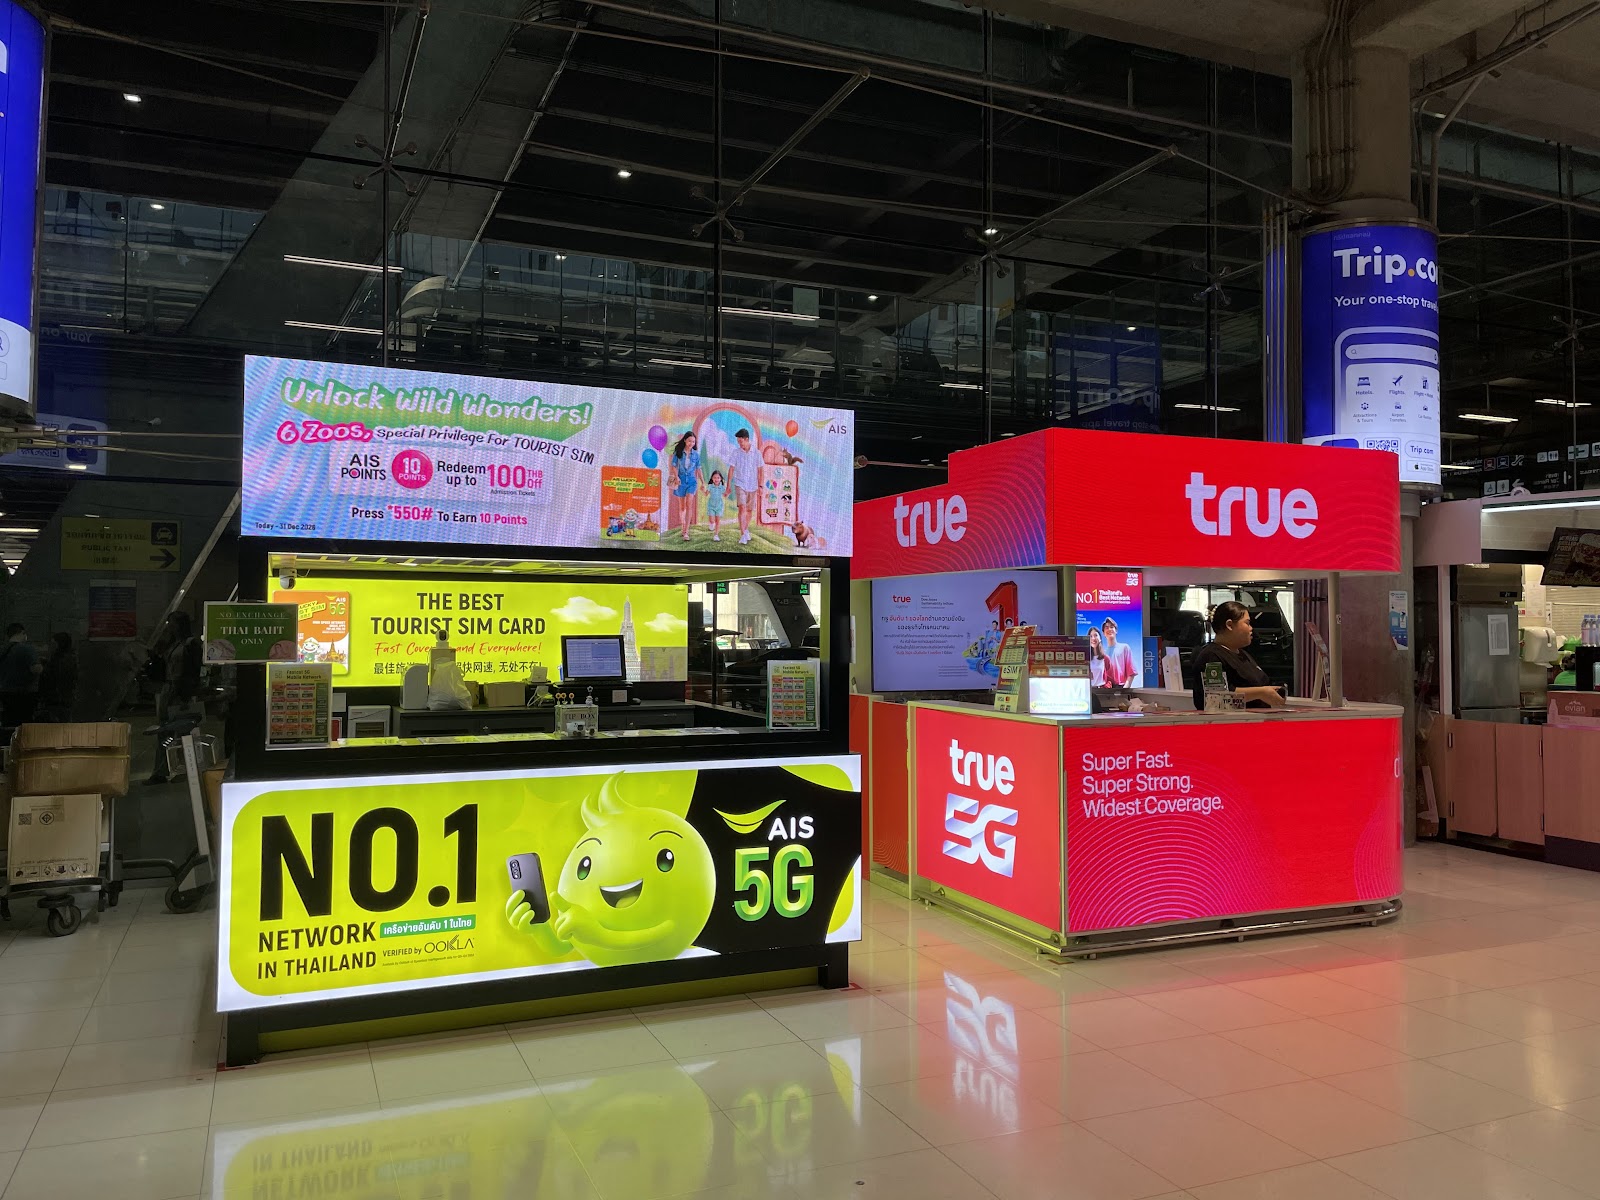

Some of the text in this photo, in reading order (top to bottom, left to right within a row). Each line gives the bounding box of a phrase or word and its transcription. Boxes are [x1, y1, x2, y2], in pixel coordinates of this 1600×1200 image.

[1334, 246, 1438, 284] Trip.co
[1334, 295, 1365, 308] Your
[1369, 294, 1419, 309] one-stop
[284, 378, 590, 425] Unlock Wild Wonders!
[828, 425, 847, 435] AIS
[279, 423, 595, 466] 6 Zoos, Special Privilege For TOURIST SIM
[350, 454, 380, 467] AIS
[403, 457, 421, 473] 10
[438, 461, 486, 475] Redeem
[341, 468, 386, 481] POINTS
[398, 473, 427, 482] POINTS
[446, 475, 477, 487] up to
[487, 464, 526, 489] 100
[527, 469, 543, 479] THB
[527, 478, 543, 489] Off
[1185, 471, 1319, 538] true
[352, 507, 384, 519] Press
[438, 511, 451, 522] To
[452, 512, 477, 523] Earn
[480, 513, 491, 523] 10
[494, 513, 528, 525] Points
[893, 494, 968, 548] true
[255, 522, 274, 531] Today
[288, 523, 299, 531] Dec
[1126, 578, 1138, 586] 5G
[417, 592, 504, 611] THE BEST
[892, 595, 911, 603] true
[236, 611, 287, 619] EXCHANGE
[329, 603, 346, 616] 5G
[220, 626, 284, 635] THAI BAHT
[371, 617, 545, 635] TOURIST SIM CARD
[375, 642, 401, 657] Fast
[479, 642, 542, 658] Everywhere!
[1003, 666, 1018, 675] eSIM
[1144, 650, 1156, 674] dtac
[1564, 704, 1586, 712] evian
[949, 738, 1015, 795] true
[1082, 751, 1174, 772] Super Fast.
[1082, 774, 1194, 796] Super Strong.
[1082, 795, 1225, 818] Widest Coverage.
[768, 815, 815, 841] AIS
[942, 793, 1018, 878] 5G
[259, 803, 478, 921] NO.1
[734, 844, 814, 921] 5G
[384, 918, 472, 935] เครือข่ายอันดับ 1 ในไทย
[258, 921, 376, 953] NETWORK
[383, 934, 474, 957] VERIFIED by OOKLA
[257, 961, 277, 980] IN
[284, 951, 377, 976] THAILAND
